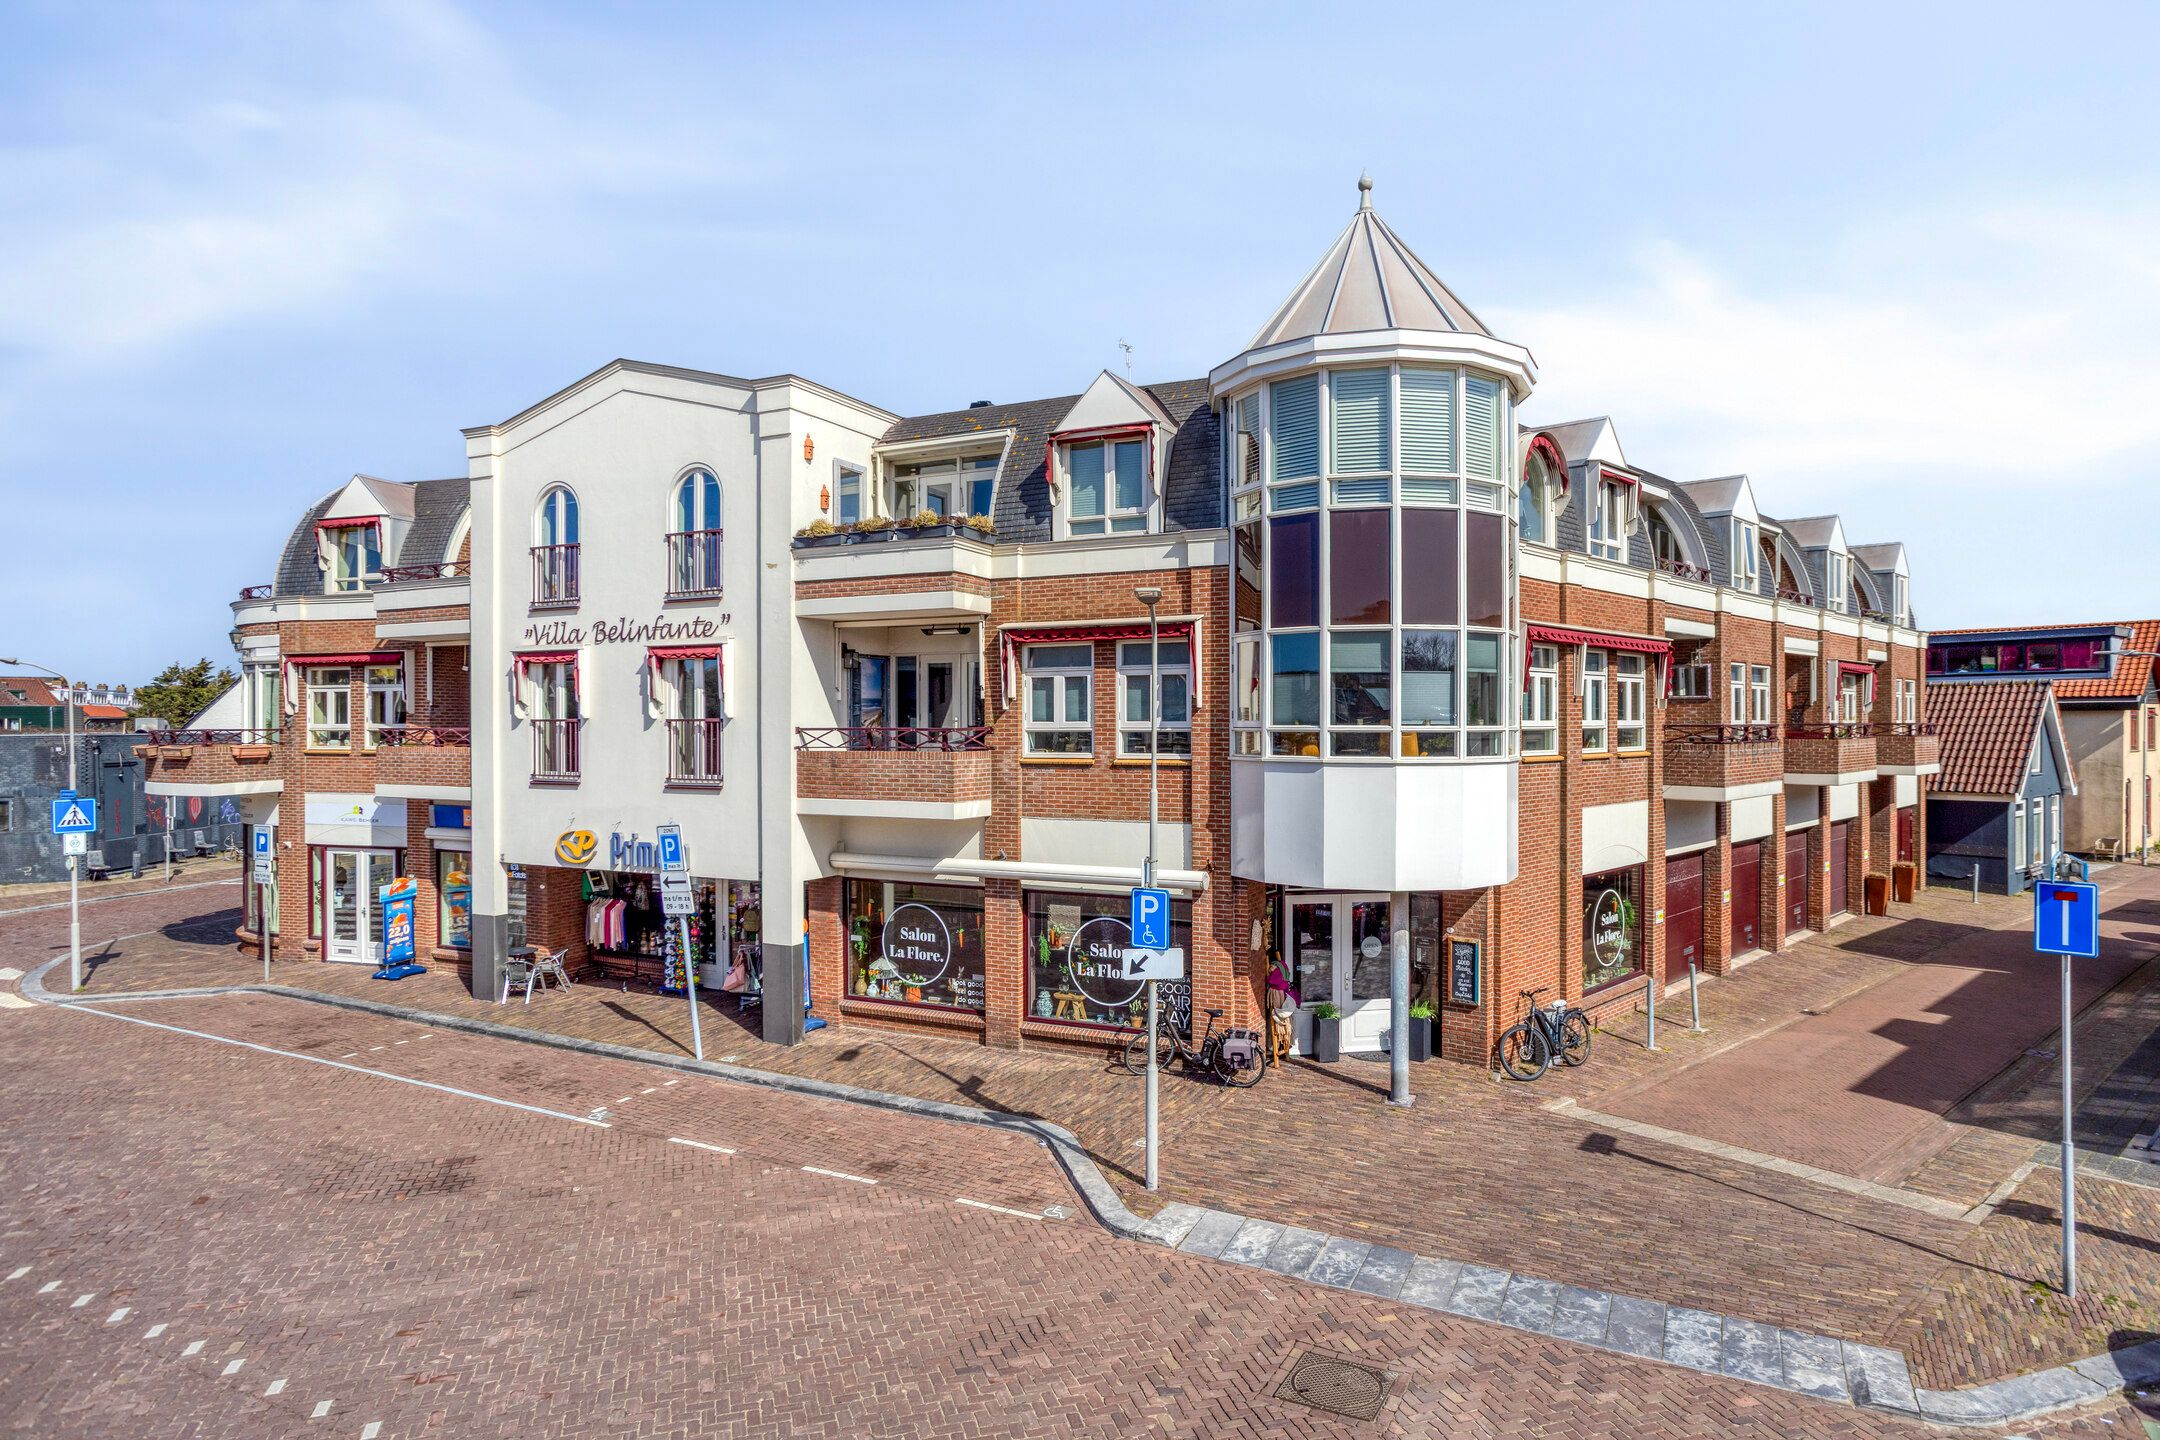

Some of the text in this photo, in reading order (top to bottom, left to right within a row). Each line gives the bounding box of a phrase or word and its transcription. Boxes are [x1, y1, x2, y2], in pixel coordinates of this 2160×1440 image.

[664, 838, 676, 860] P
[1140, 895, 1159, 923] P
[1601, 911, 1619, 926] Salon
[388, 924, 410, 939] 22,0
[900, 926, 936, 943] Salon
[1596, 933, 1604, 946] La
[889, 944, 944, 963] La Flore.
[1090, 943, 1123, 959] Salo
[1077, 962, 1124, 980] La Flo
[1156, 982, 1191, 995] GOOD
